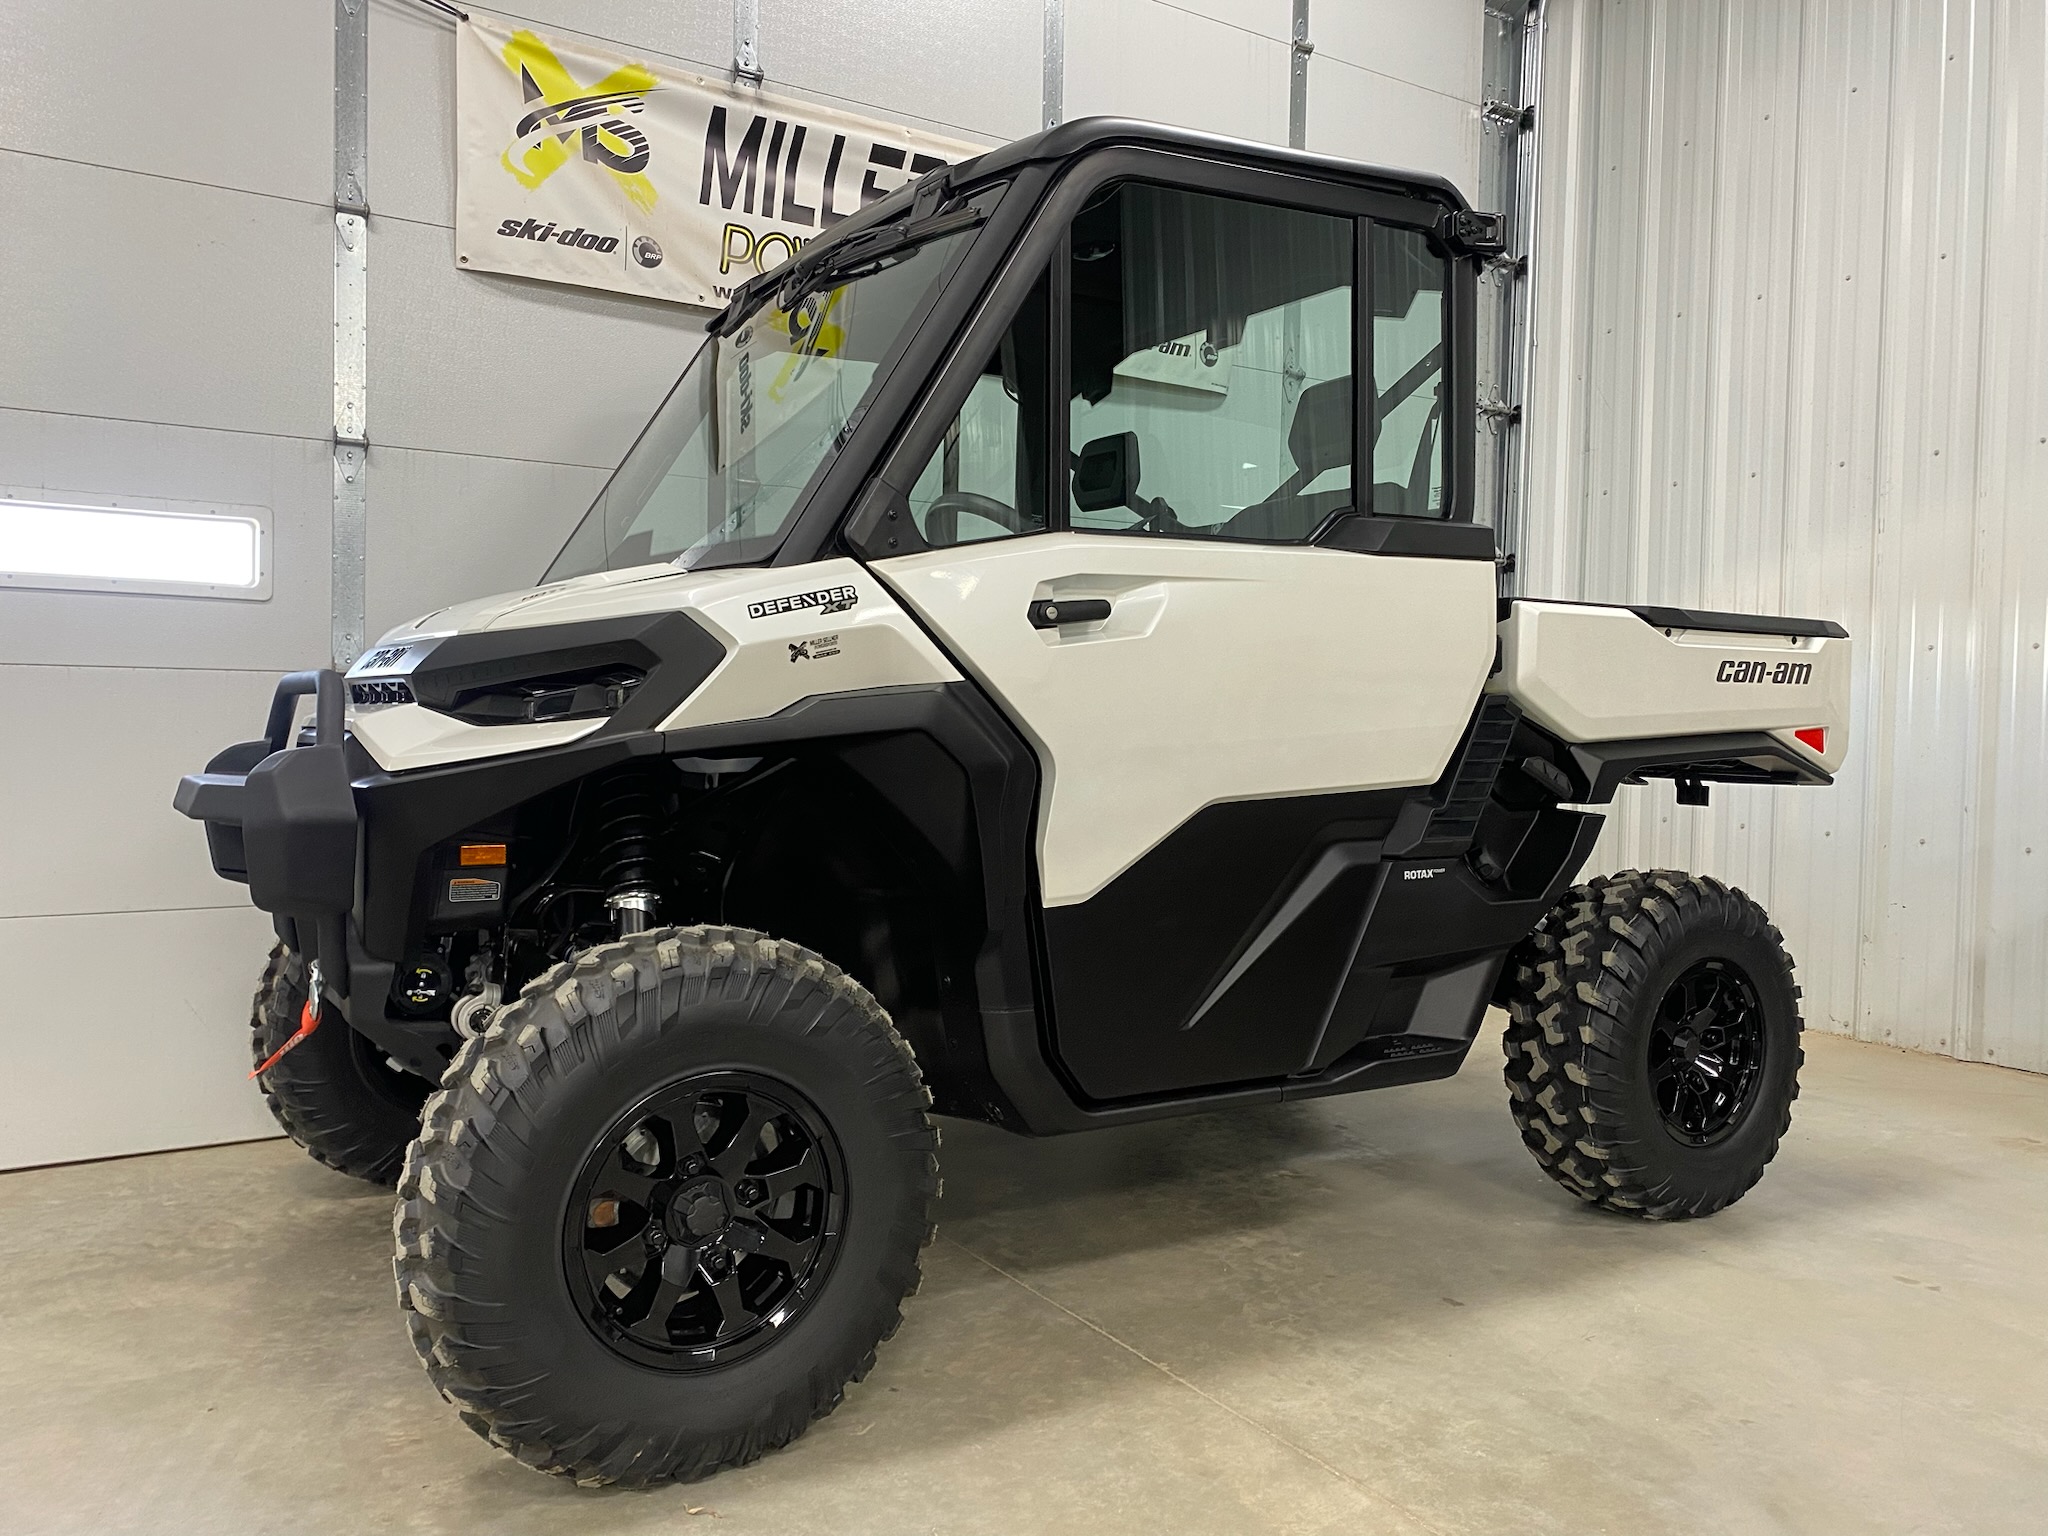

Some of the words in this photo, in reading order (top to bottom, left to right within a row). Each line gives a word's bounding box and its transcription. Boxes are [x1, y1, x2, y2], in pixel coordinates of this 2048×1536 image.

[700, 105, 949, 229] MILLE
[497, 218, 620, 254] ski-doo
[719, 223, 813, 274] PO
[644, 252, 662, 260] BRP
[748, 586, 856, 618] DEFENDER
[821, 599, 857, 614] XT
[1716, 660, 1813, 684] can-am
[1404, 869, 1434, 880] ROTAX
